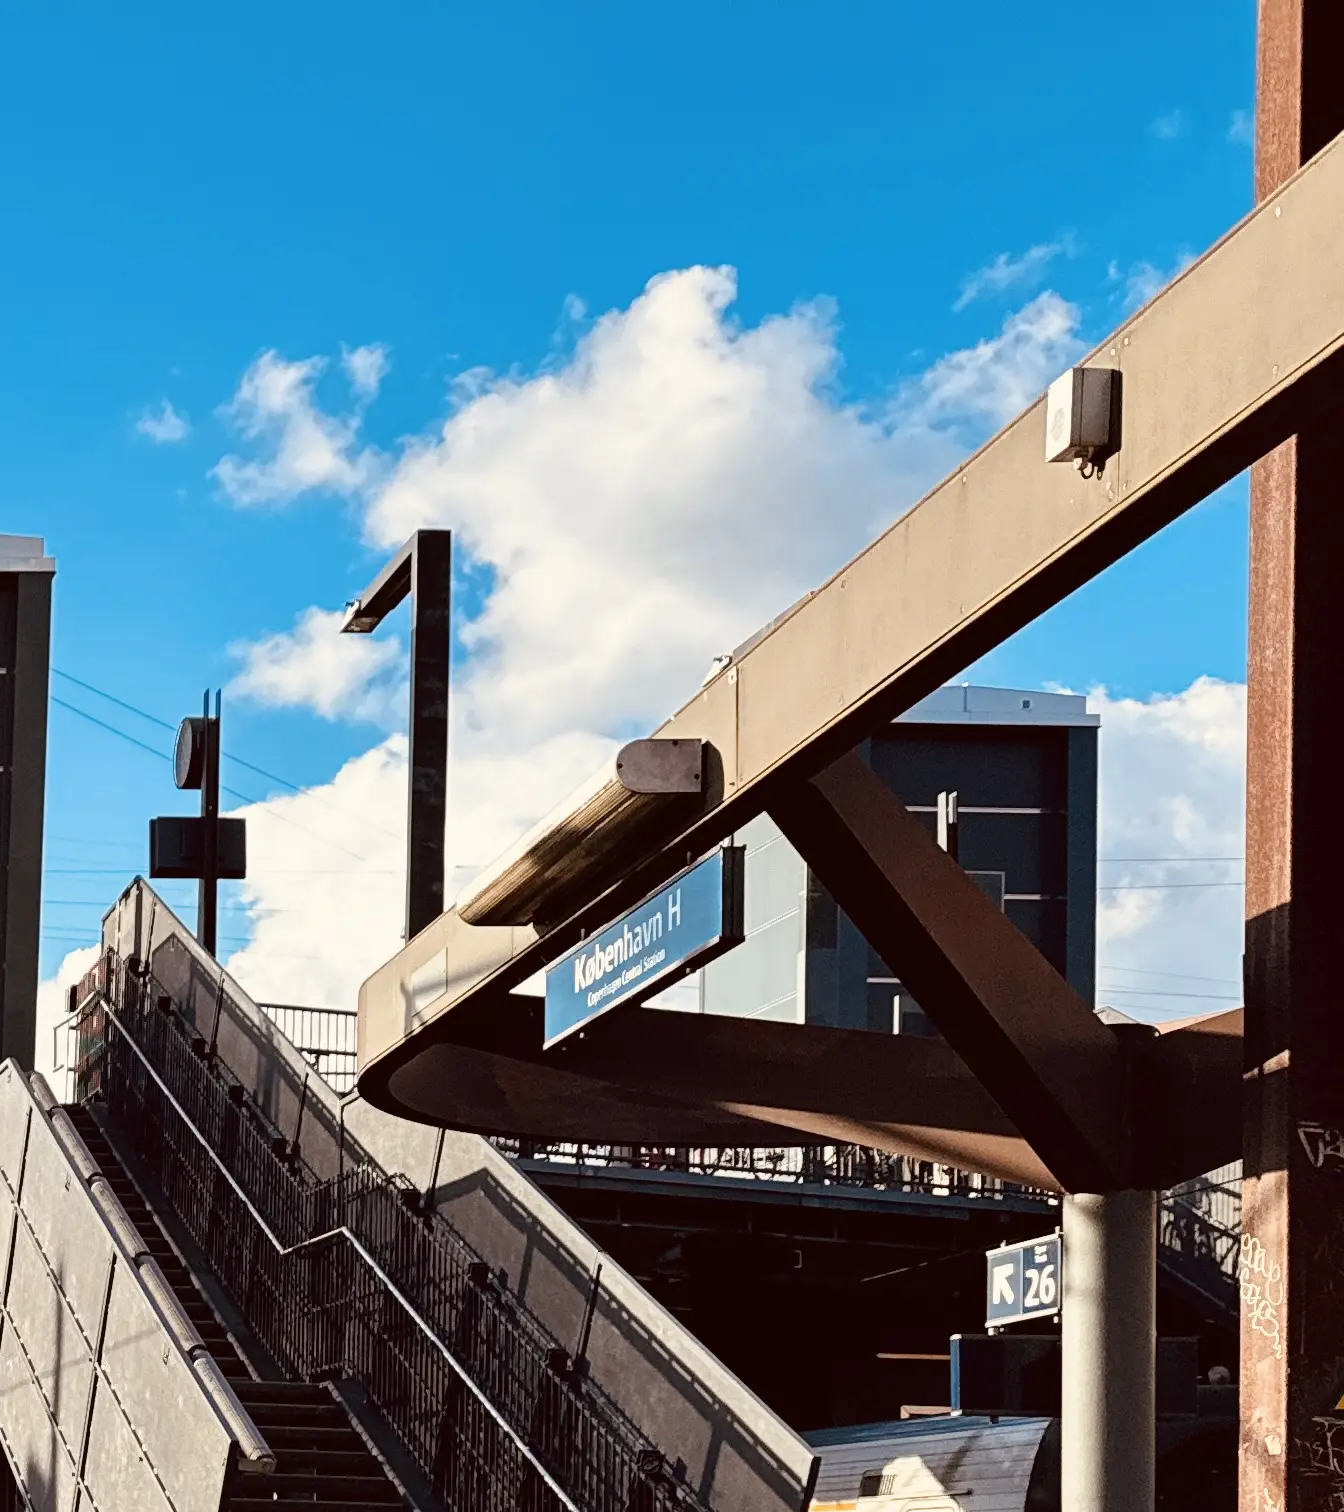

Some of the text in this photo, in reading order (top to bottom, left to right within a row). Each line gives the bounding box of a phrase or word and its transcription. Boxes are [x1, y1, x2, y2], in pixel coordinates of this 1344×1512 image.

[573, 887, 681, 993] København H
[587, 949, 666, 1007] Copenhagen Central Station
[1023, 1264, 1056, 1308] 26
